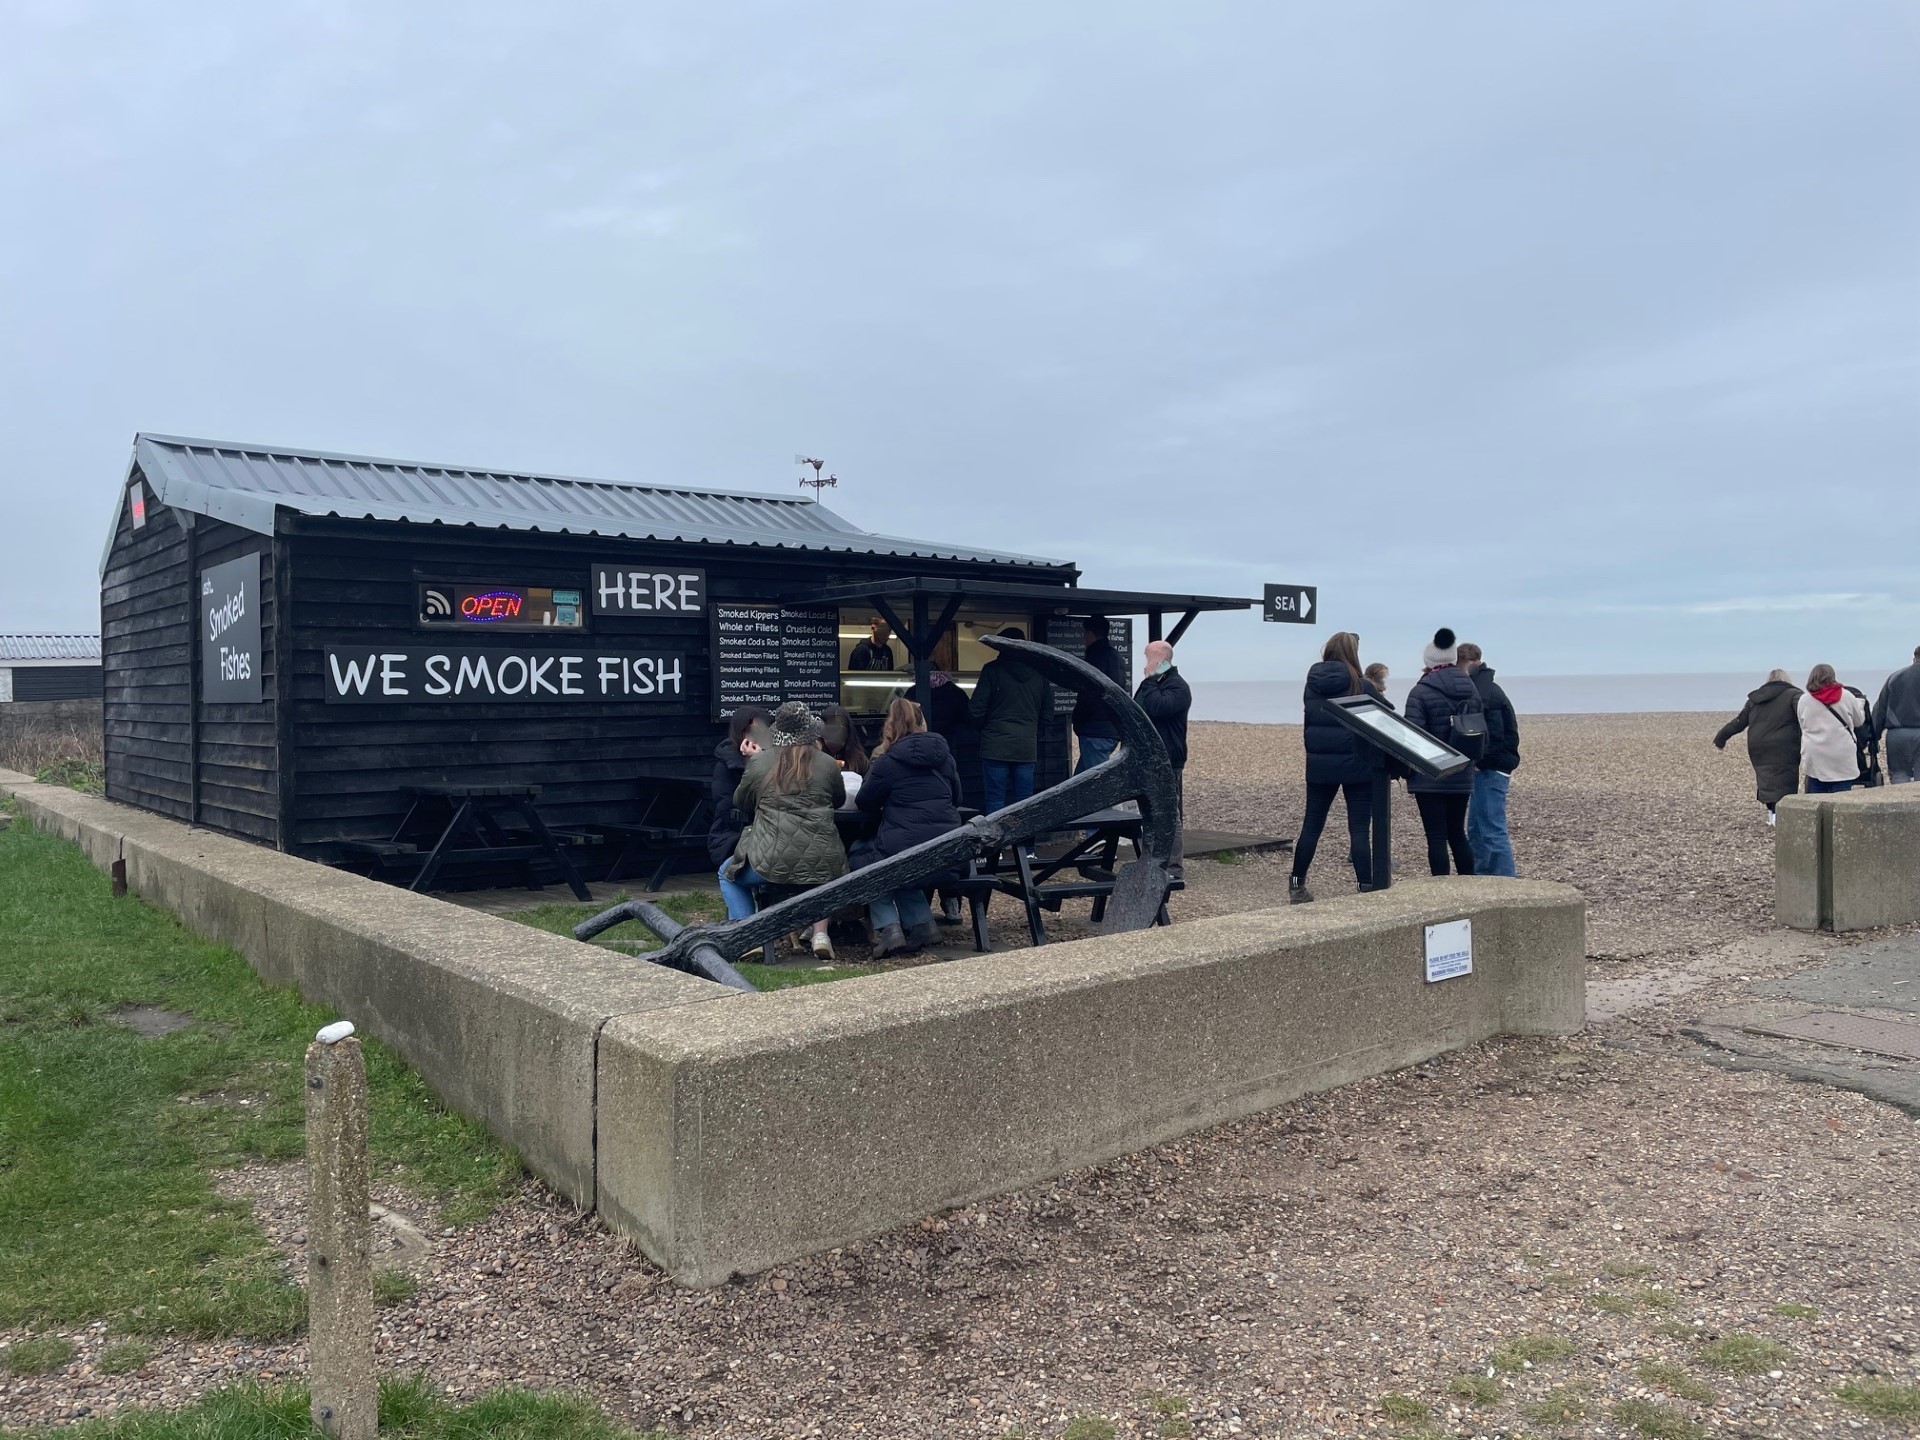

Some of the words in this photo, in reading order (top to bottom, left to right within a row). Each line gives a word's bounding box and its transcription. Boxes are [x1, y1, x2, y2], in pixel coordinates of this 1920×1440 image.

[598, 571, 700, 611] HERE
[461, 596, 522, 616] OPEN
[1275, 596, 1295, 611] SEA
[209, 582, 245, 642] Smoked
[718, 609, 749, 618] Smoked
[750, 610, 778, 620] Kippers
[781, 610, 807, 618] Smoked
[719, 623, 743, 631] Whole
[756, 623, 778, 632] Fillets
[786, 625, 815, 633] Crusted
[782, 637, 810, 646] Smoked
[220, 646, 251, 680] Fishes
[330, 653, 409, 696] WE
[424, 654, 585, 696] SMOKE
[596, 656, 682, 695] FISH
